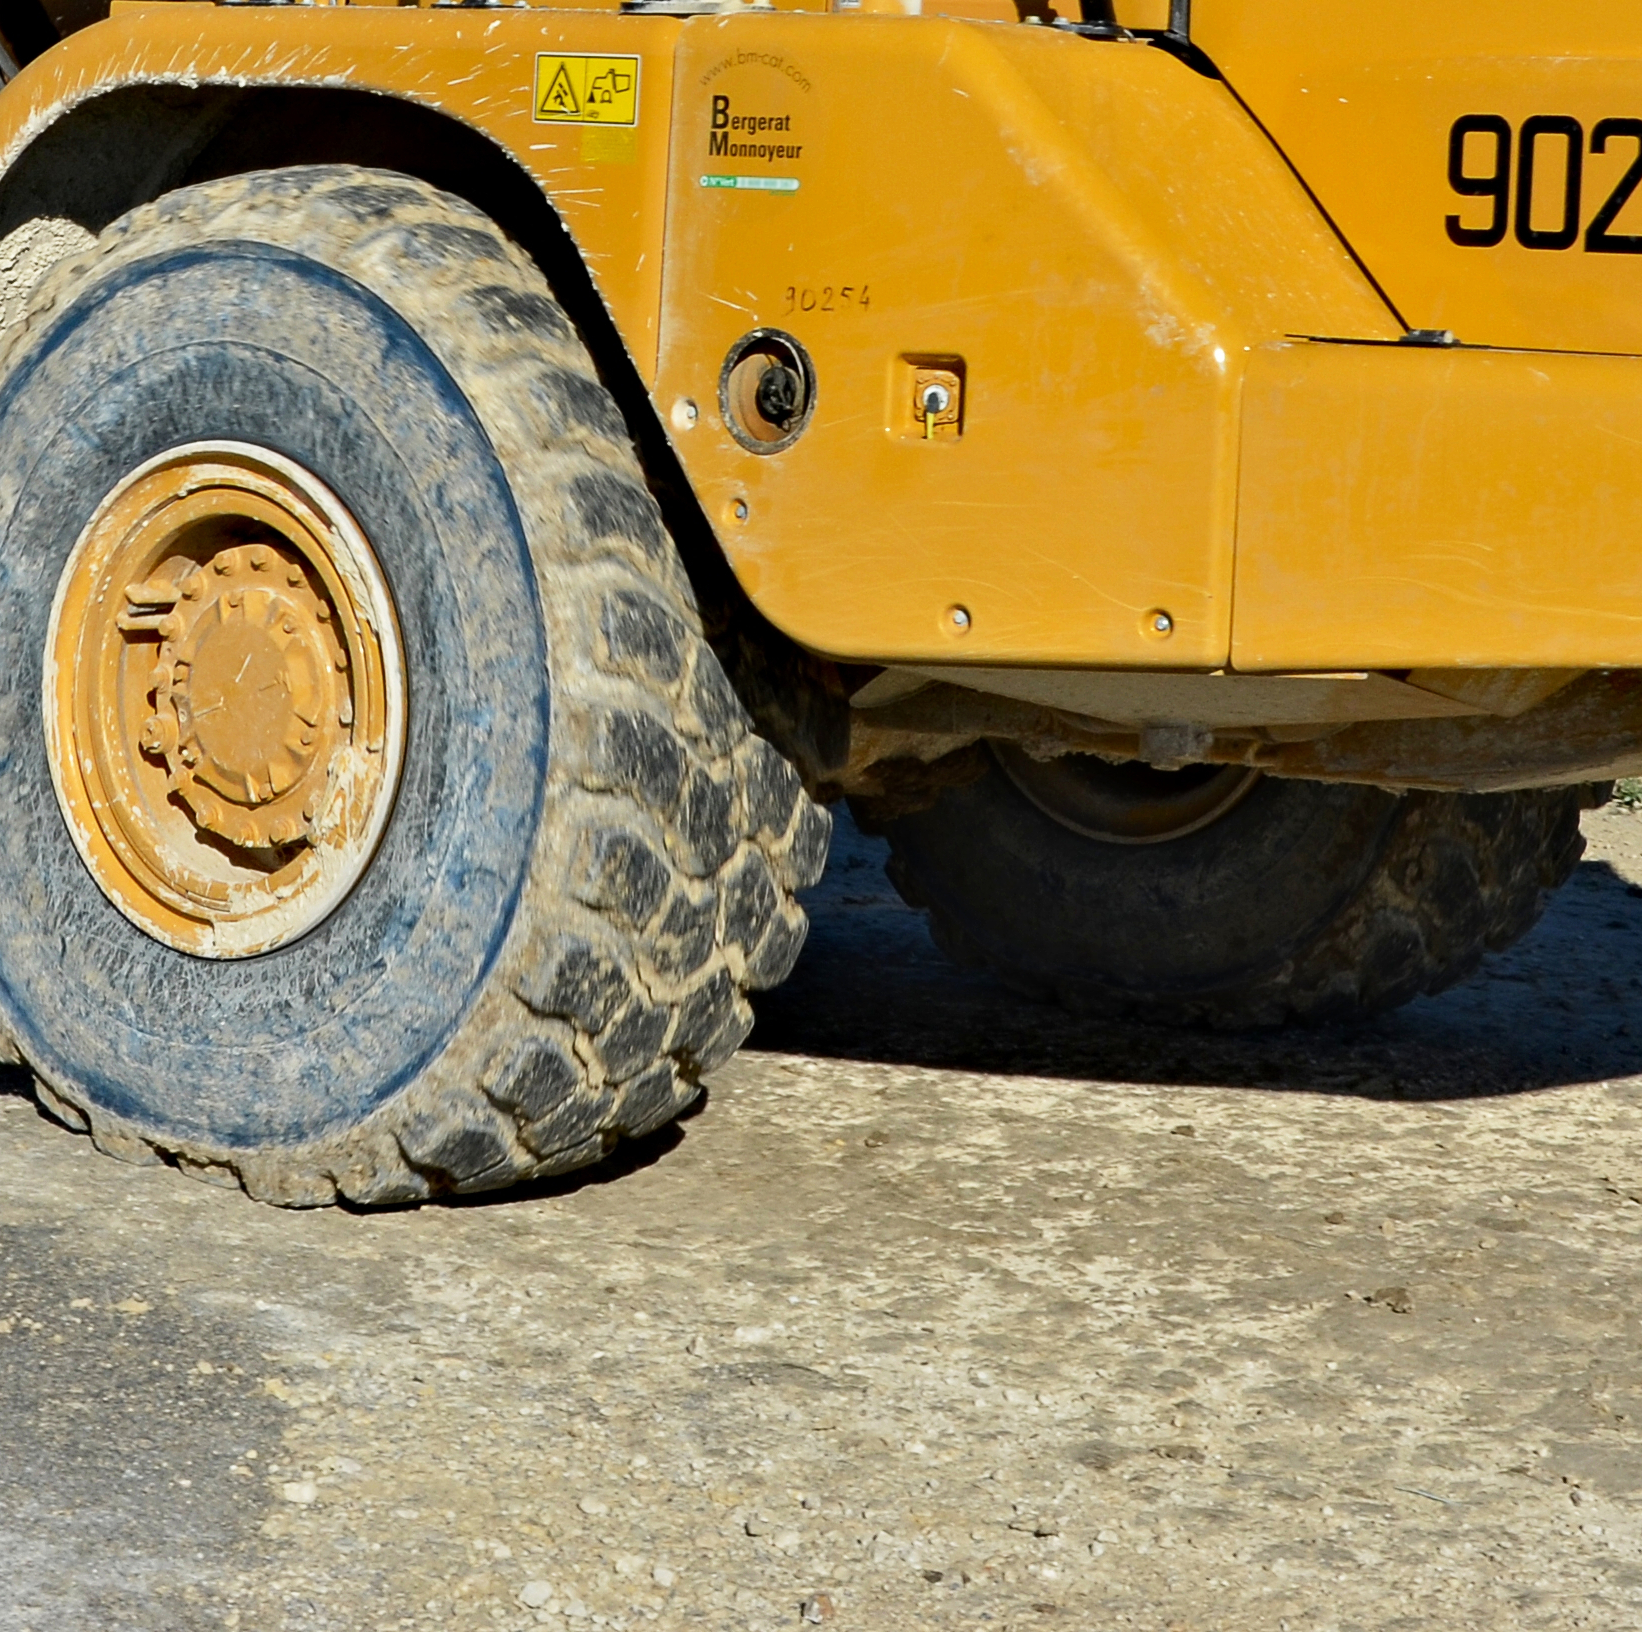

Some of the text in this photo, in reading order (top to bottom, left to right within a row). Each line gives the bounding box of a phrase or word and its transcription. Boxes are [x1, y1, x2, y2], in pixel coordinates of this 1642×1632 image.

[699, 48, 812, 94] www.bm-cat.com
[711, 95, 791, 135] Bergerat
[709, 131, 803, 162] Monnoyeur
[781, 285, 870, 319] 90254
